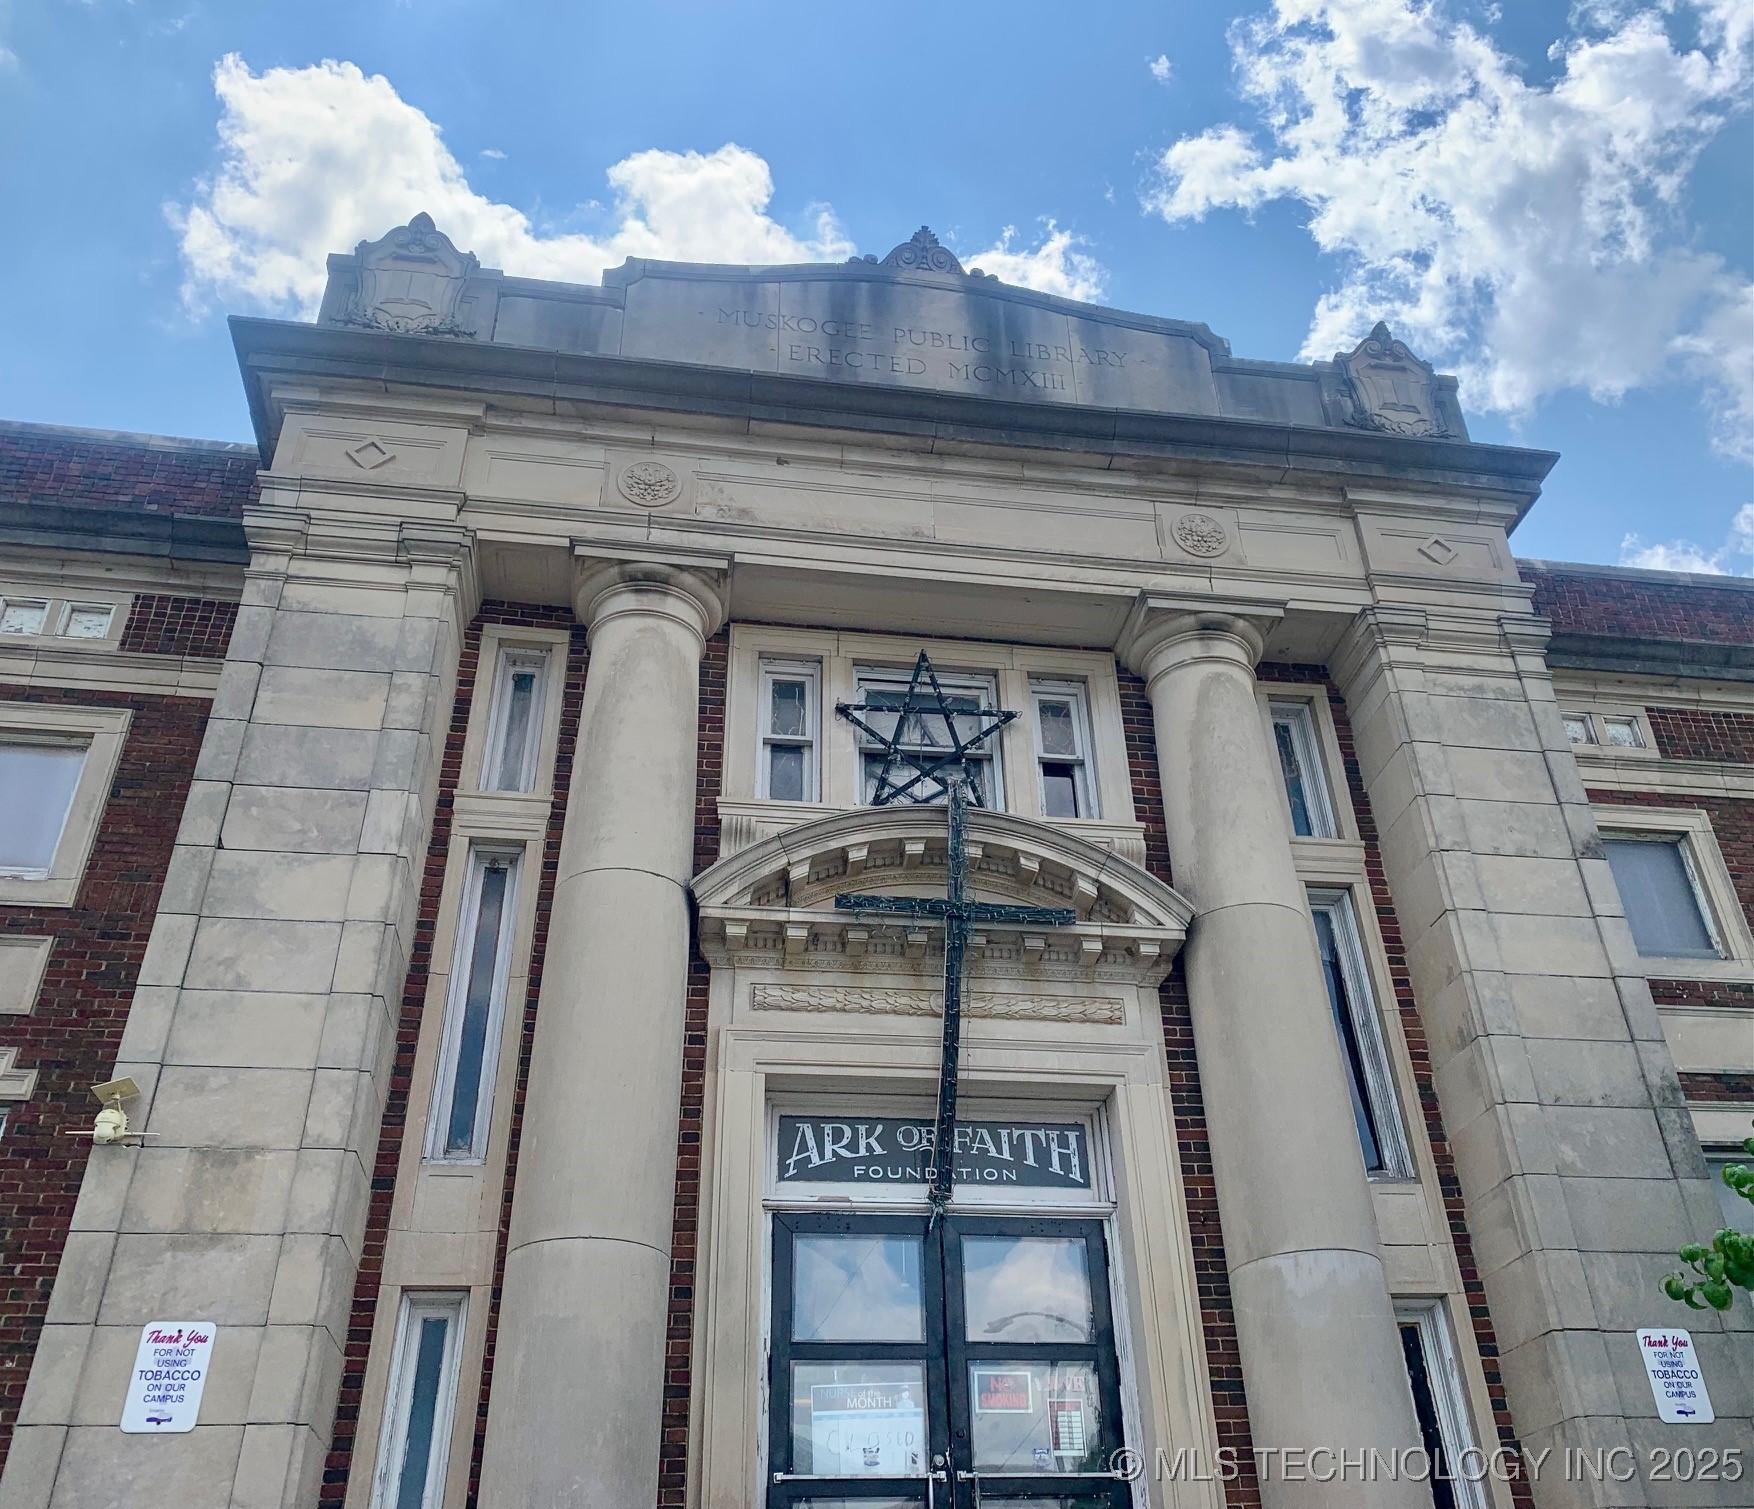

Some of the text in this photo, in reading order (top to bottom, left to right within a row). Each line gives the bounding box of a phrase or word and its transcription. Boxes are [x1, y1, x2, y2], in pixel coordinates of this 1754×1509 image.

[716, 308, 1128, 369] MUSKOGEE PUBLIC LIBRARY
[789, 344, 1067, 391] ERECTED MCMXIII
[784, 1123, 888, 1178] ARK
[953, 1126, 1084, 1183] FAITH
[853, 1166, 1017, 1181] FOUNDTION
[146, 1329, 209, 1349] Thank You
[1642, 1335, 1688, 1351] Thank You
[153, 1348, 196, 1357] FOR NOT
[1653, 1351, 1684, 1359] FOR NOT
[157, 1359, 187, 1368] USING
[1660, 1360, 1683, 1368] USING
[139, 1370, 201, 1381] TOBACCO
[1651, 1370, 1698, 1379] TOBACCO
[147, 1383, 186, 1392] ON OUR
[1663, 1381, 1693, 1389] ON OUR
[857, 1389, 867, 1398] of
[867, 1388, 881, 1397] the
[1665, 1390, 1697, 1399] CAMPUS
[143, 1394, 185, 1403] CAMPUS
[846, 1397, 892, 1409] MONTH
